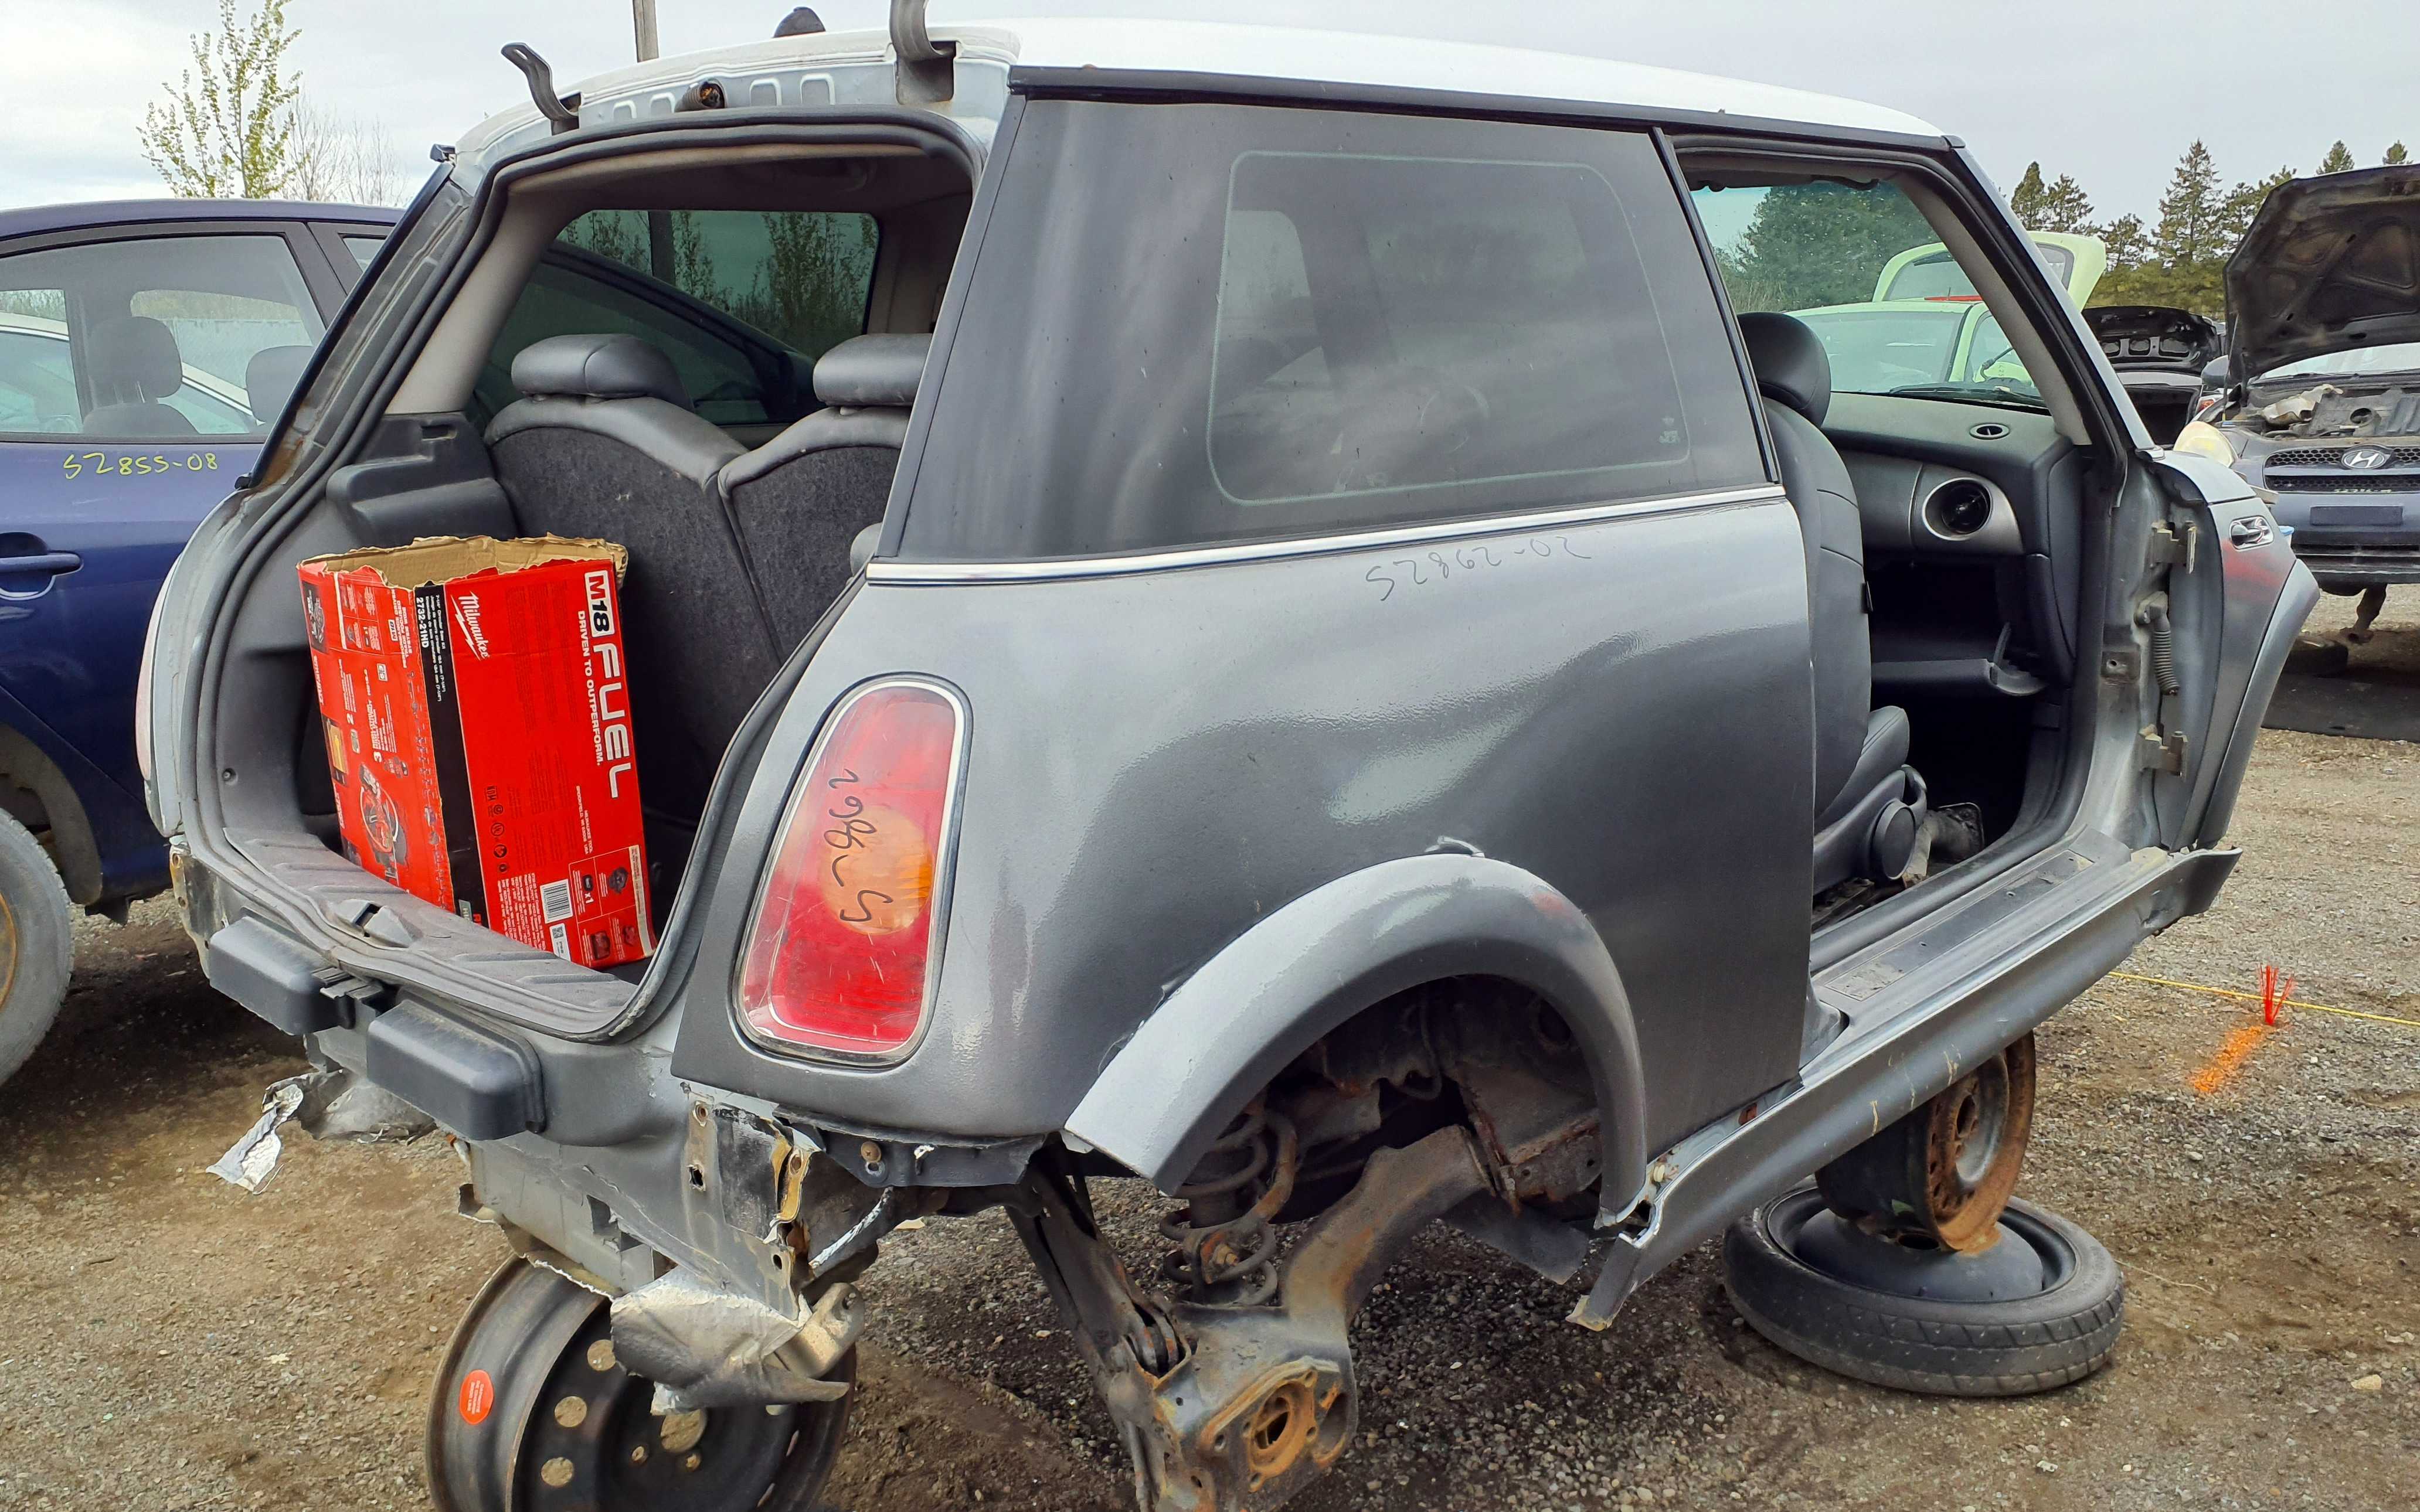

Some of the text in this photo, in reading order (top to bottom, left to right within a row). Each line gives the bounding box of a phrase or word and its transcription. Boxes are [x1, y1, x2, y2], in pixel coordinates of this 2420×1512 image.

[416, 597, 429, 648] 2732-21HD
[457, 590, 490, 660] Milwaukee
[578, 610, 601, 766] DRIVEN TO OUTPERFORM.
[589, 574, 631, 798] M18 FUEL
[346, 712, 354, 725] 2
[373, 750, 382, 763] 3
[584, 891, 594, 904] x1
